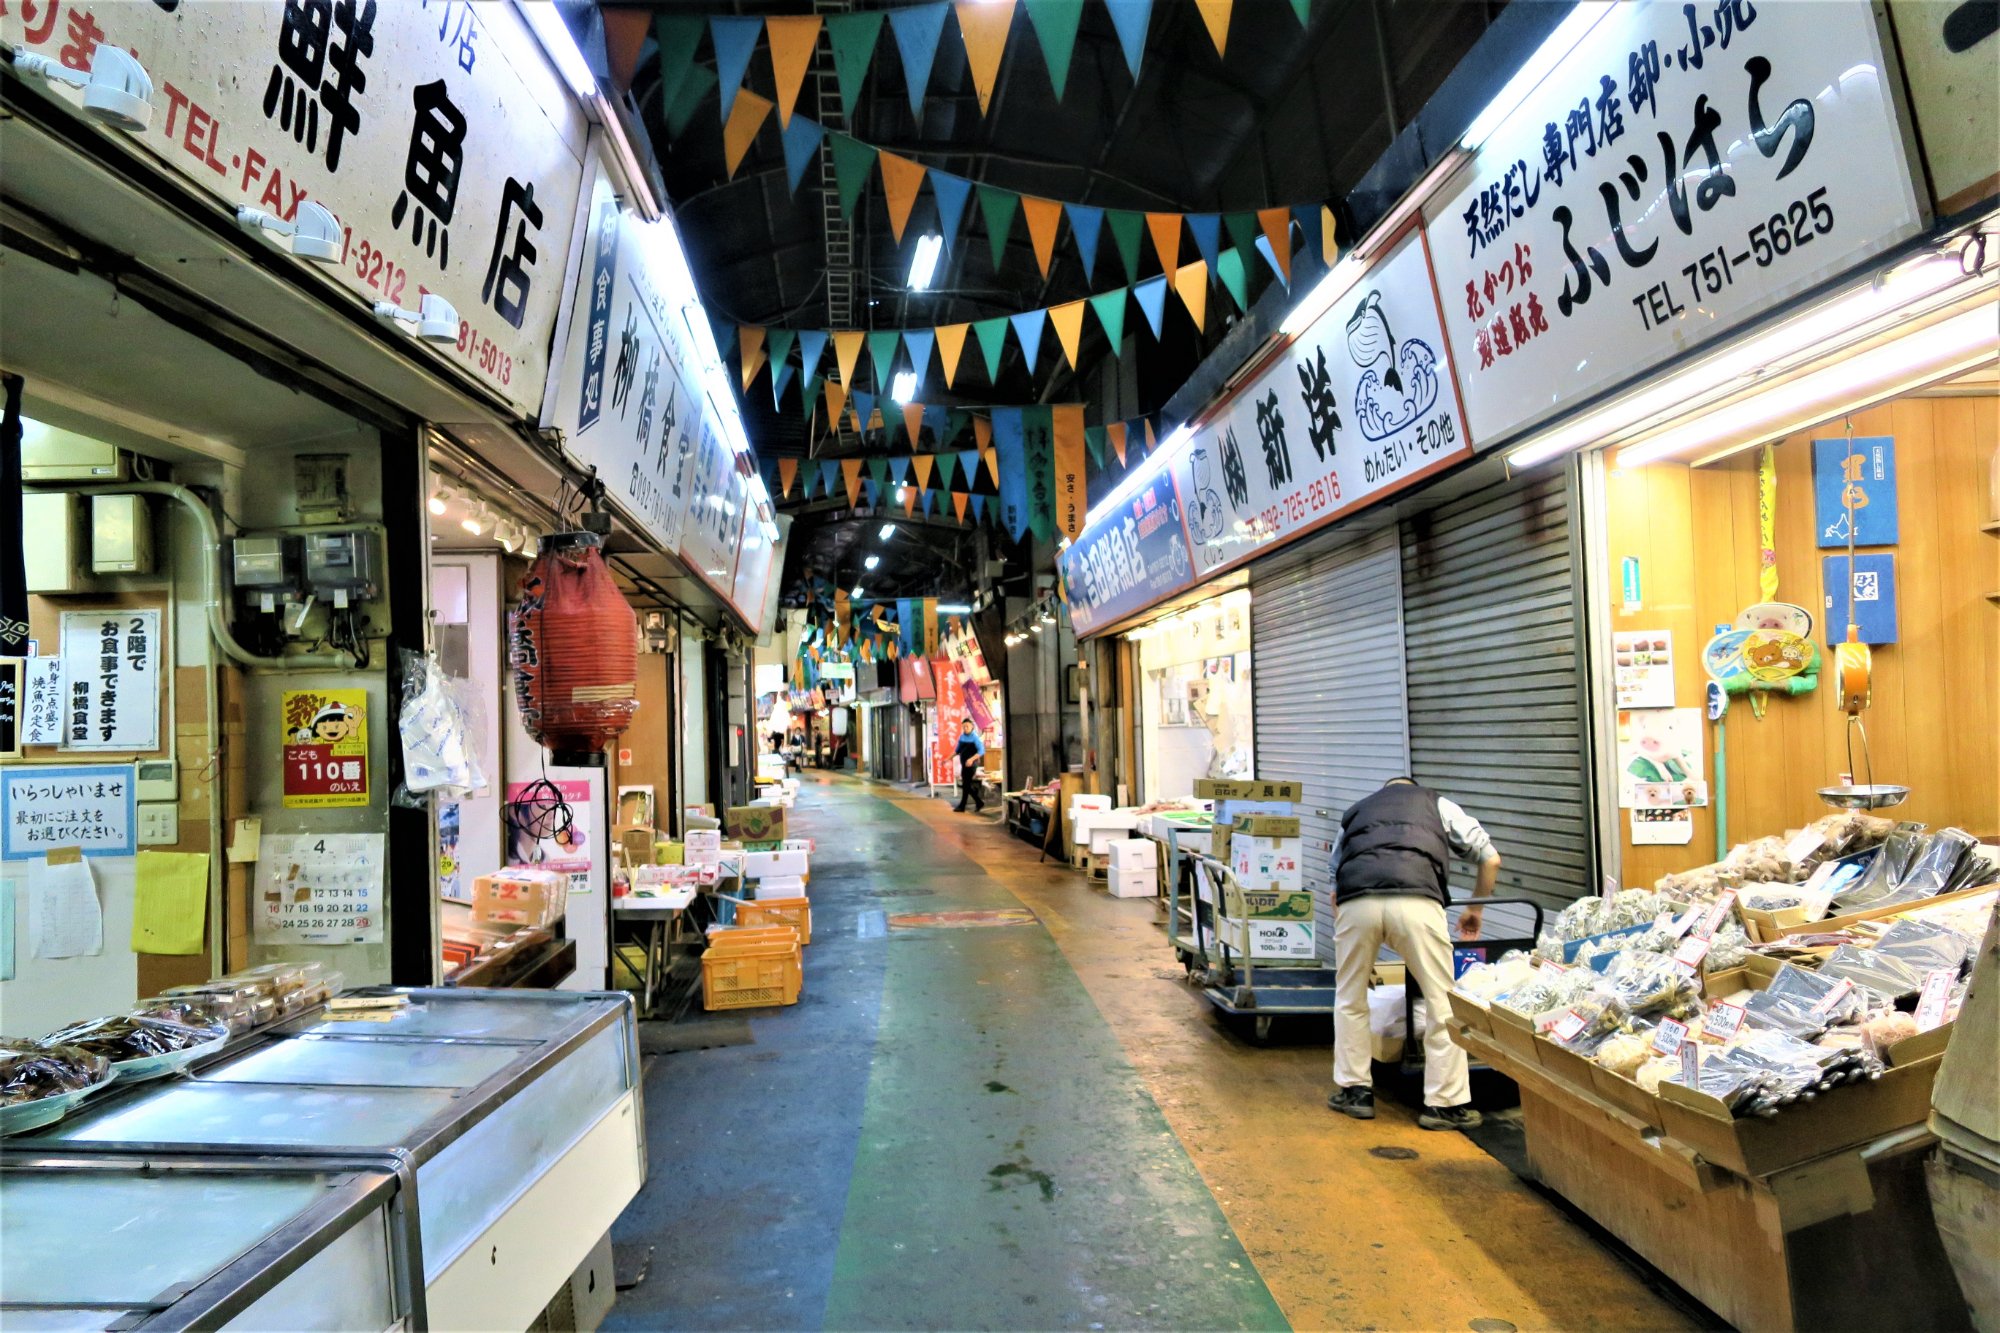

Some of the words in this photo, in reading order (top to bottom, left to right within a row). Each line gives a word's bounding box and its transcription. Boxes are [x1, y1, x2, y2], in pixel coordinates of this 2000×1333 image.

[1553, 56, 1815, 317] ふじはら
[1465, 242, 1532, 323] 花かつお
[1632, 271, 1685, 331] TEL
[1682, 188, 1834, 303] 751-5625
[455, 315, 513, 386] 81-5013
[1473, 291, 1549, 371] 製造販売
[611, 301, 690, 499] 柳橋食堂
[1363, 411, 1456, 484] めんたい・その他
[1065, 473, 1077, 533] 安さ・うまさ
[127, 617, 147, 672] 2階で
[29, 676, 46, 742] 焼魚の定食
[44, 660, 60, 731] 刺身三点盛と
[99, 620, 120, 742] お食事できます
[72, 681, 90, 741] 柳橋食堂
[288, 750, 318, 761] こども
[299, 761, 361, 781] 110番
[12, 782, 124, 801] いらっしゃいませ
[329, 782, 361, 792] のいえ
[1263, 785, 1292, 797] 長崎
[16, 809, 104, 825] 最初にご注文を
[313, 839, 326, 854] 4
[283, 904, 295, 913] 17
[298, 904, 309, 913] 18
[313, 904, 324, 913] 19
[326, 904, 339, 913] 20
[342, 904, 353, 913] 21
[356, 903, 369, 913] 22
[314, 889, 324, 898] 12
[328, 889, 339, 898] 13
[342, 889, 353, 898] 14
[357, 888, 368, 897] 15
[1246, 897, 1277, 907] いわれ
[282, 919, 295, 929] 24
[297, 919, 310, 928] 25
[311, 919, 324, 928] 26
[326, 919, 339, 928] 27
[341, 919, 354, 928] 28
